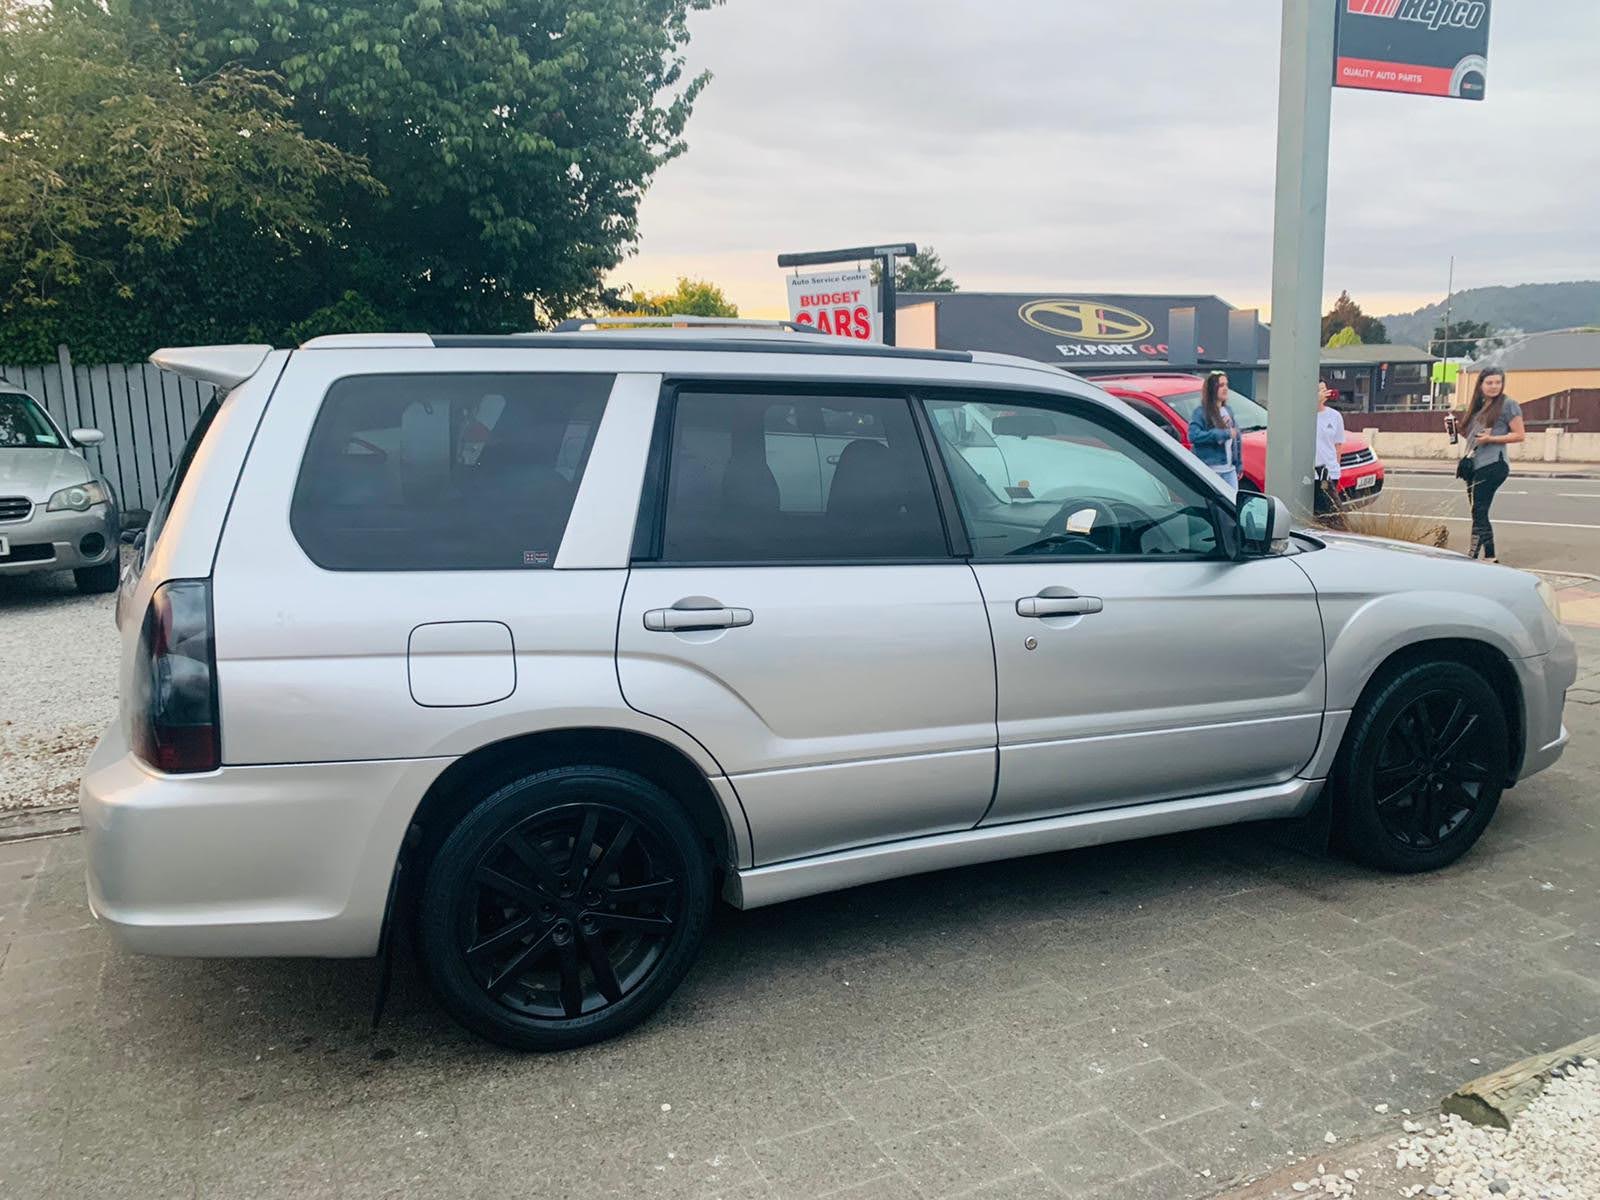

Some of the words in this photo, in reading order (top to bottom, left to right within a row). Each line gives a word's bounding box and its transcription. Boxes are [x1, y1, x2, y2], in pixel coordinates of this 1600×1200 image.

[1399, 0, 1485, 30] Repco
[1343, 67, 1374, 78] QUALITY
[1376, 71, 1397, 81] AUTO
[1398, 74, 1422, 83] PARTS
[800, 291, 860, 307] BUDGET
[1055, 344, 1137, 355] EXPORT
